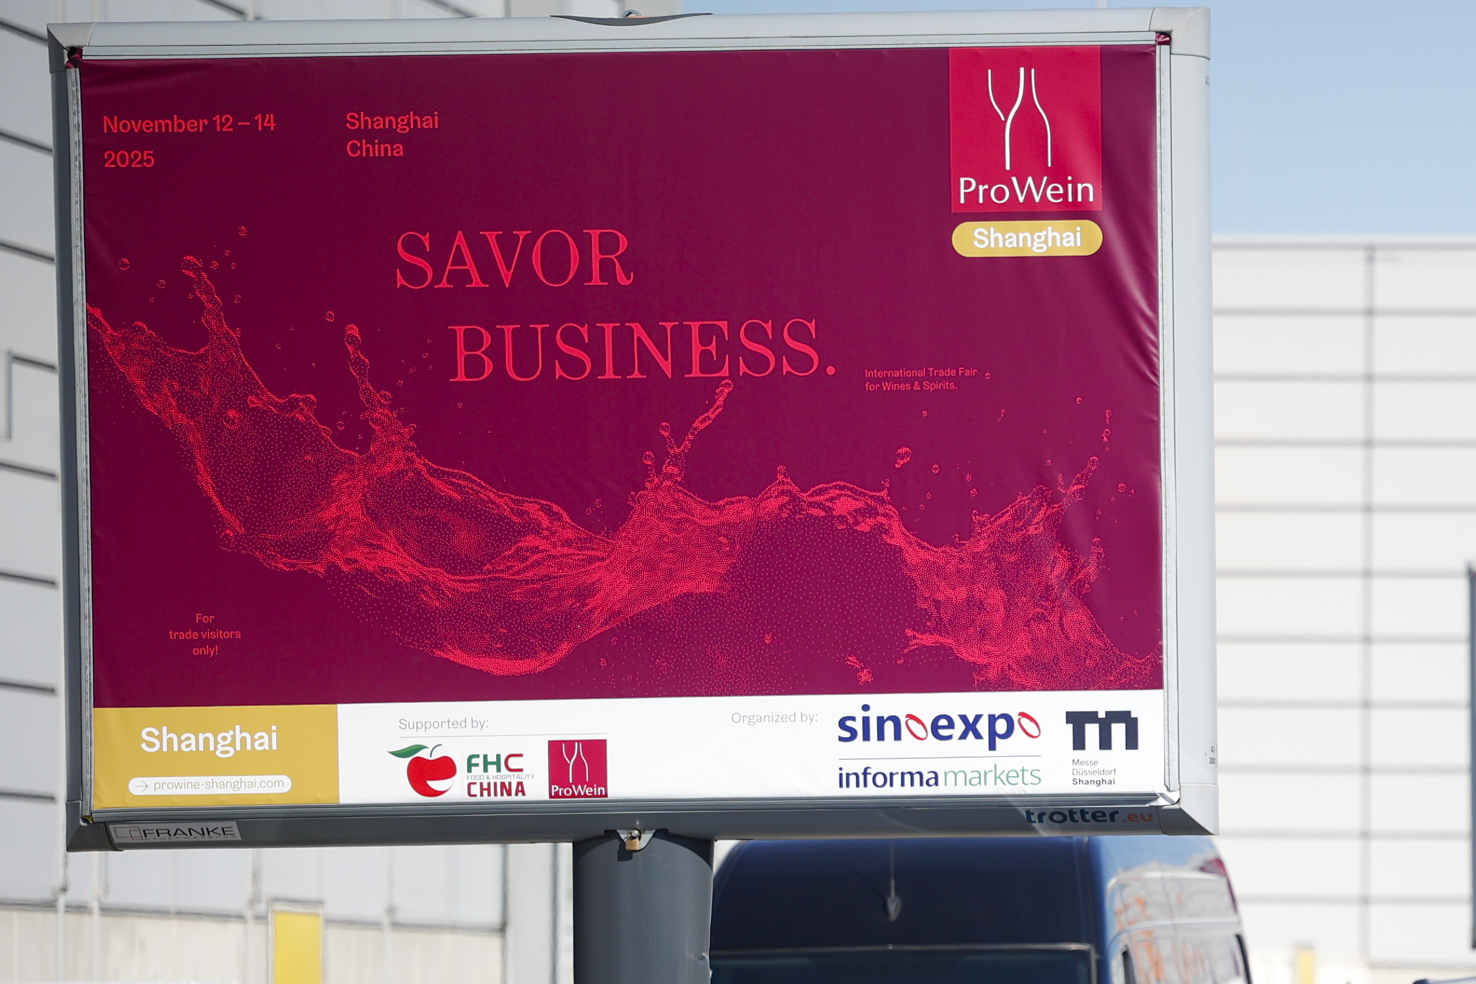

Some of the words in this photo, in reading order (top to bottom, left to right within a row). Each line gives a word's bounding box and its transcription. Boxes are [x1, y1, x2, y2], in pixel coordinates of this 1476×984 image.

[103, 115, 208, 133] November
[212, 114, 234, 132] 12
[254, 113, 276, 131] 14
[346, 111, 439, 134] Shanghai
[346, 139, 404, 157] China
[104, 150, 155, 168] 2025
[959, 175, 1095, 204] ProWein
[973, 226, 1082, 253] Shanghai
[396, 229, 634, 289] SAVOR
[448, 318, 837, 382] BUSINESS.
[864, 367, 926, 379] International
[928, 367, 957, 378] Trade
[958, 366, 978, 377] Fair
[865, 381, 880, 391] for
[882, 381, 912, 391] Wines
[913, 381, 921, 391] &
[923, 380, 958, 392] Spirits.
[195, 613, 215, 624] For
[169, 629, 199, 640] trade
[201, 629, 241, 640] visitors
[192, 645, 219, 658] only!
[399, 718, 467, 731] Supported
[471, 717, 489, 731] by:
[731, 712, 796, 726] Organized
[800, 711, 819, 724] by:
[838, 704, 1041, 751] sinoexpo
[140, 725, 278, 758] Shanghai
[467, 753, 523, 773] FHC
[1072, 759, 1099, 767] Messe
[838, 766, 939, 788] informa
[943, 764, 1042, 787] markets
[1072, 768, 1117, 776] Düsseldorf
[153, 777, 285, 792] prowine-shanghai.com
[467, 781, 526, 797] CHINA
[1072, 778, 1115, 787] Shanghai
[551, 784, 605, 797] ProWein
[143, 826, 236, 838] FRANKE
